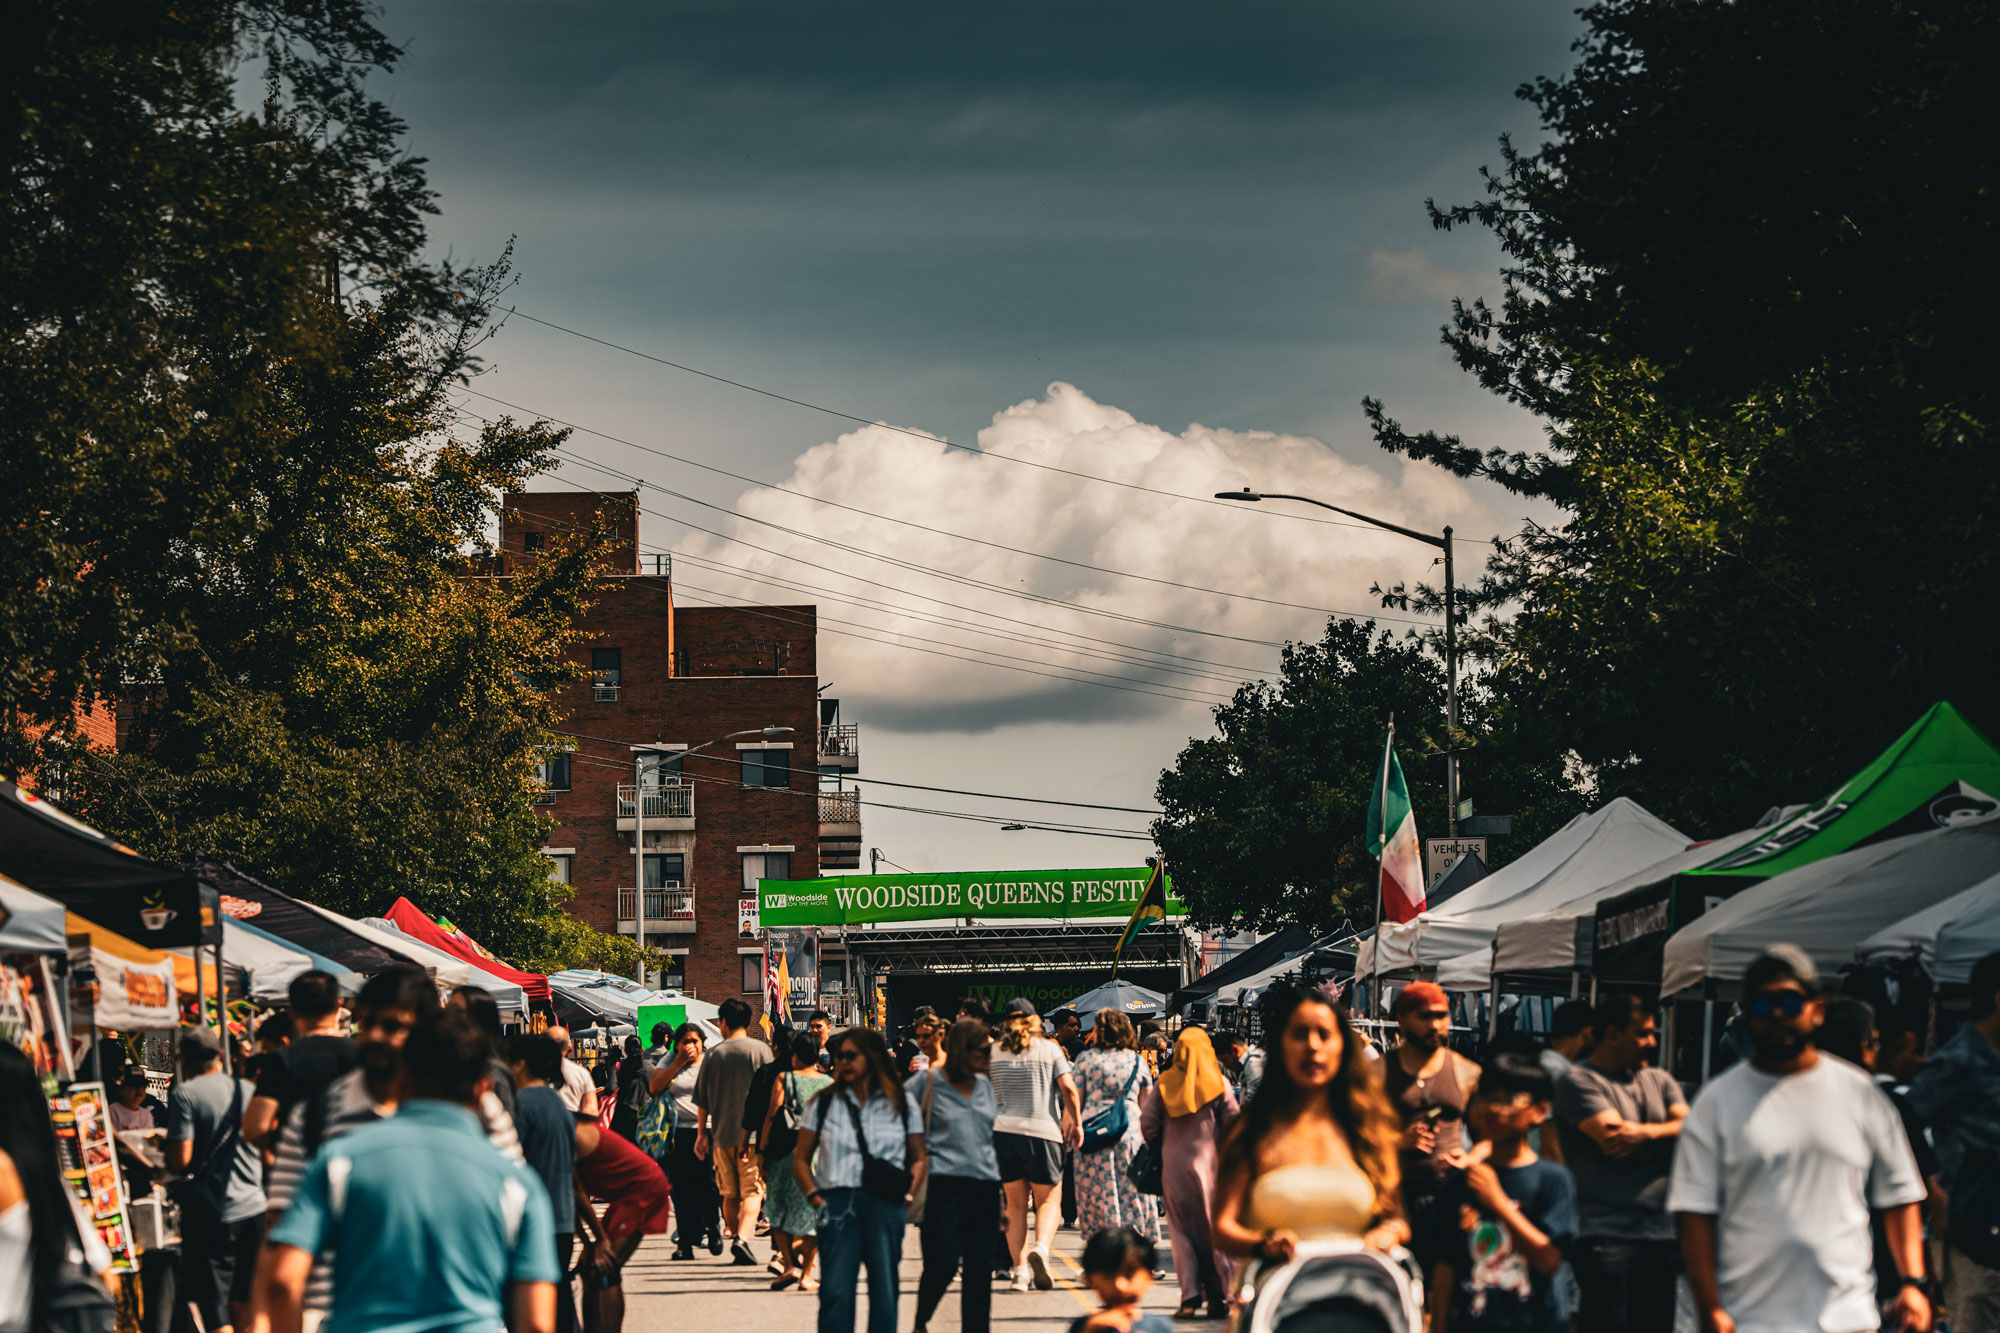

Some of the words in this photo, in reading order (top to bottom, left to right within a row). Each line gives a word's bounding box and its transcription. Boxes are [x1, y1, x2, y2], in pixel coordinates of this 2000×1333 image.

[1433, 844, 1480, 854] VEHICLES
[1443, 858, 1454, 868] O
[787, 893, 828, 902] Woodside
[834, 884, 961, 910] WOODSIDE
[967, 881, 1064, 910] QUEENS
[1071, 879, 1185, 903] FESTIV
[1020, 984, 1098, 1001] Woodsi
[1126, 1001, 1157, 1010] Corona
